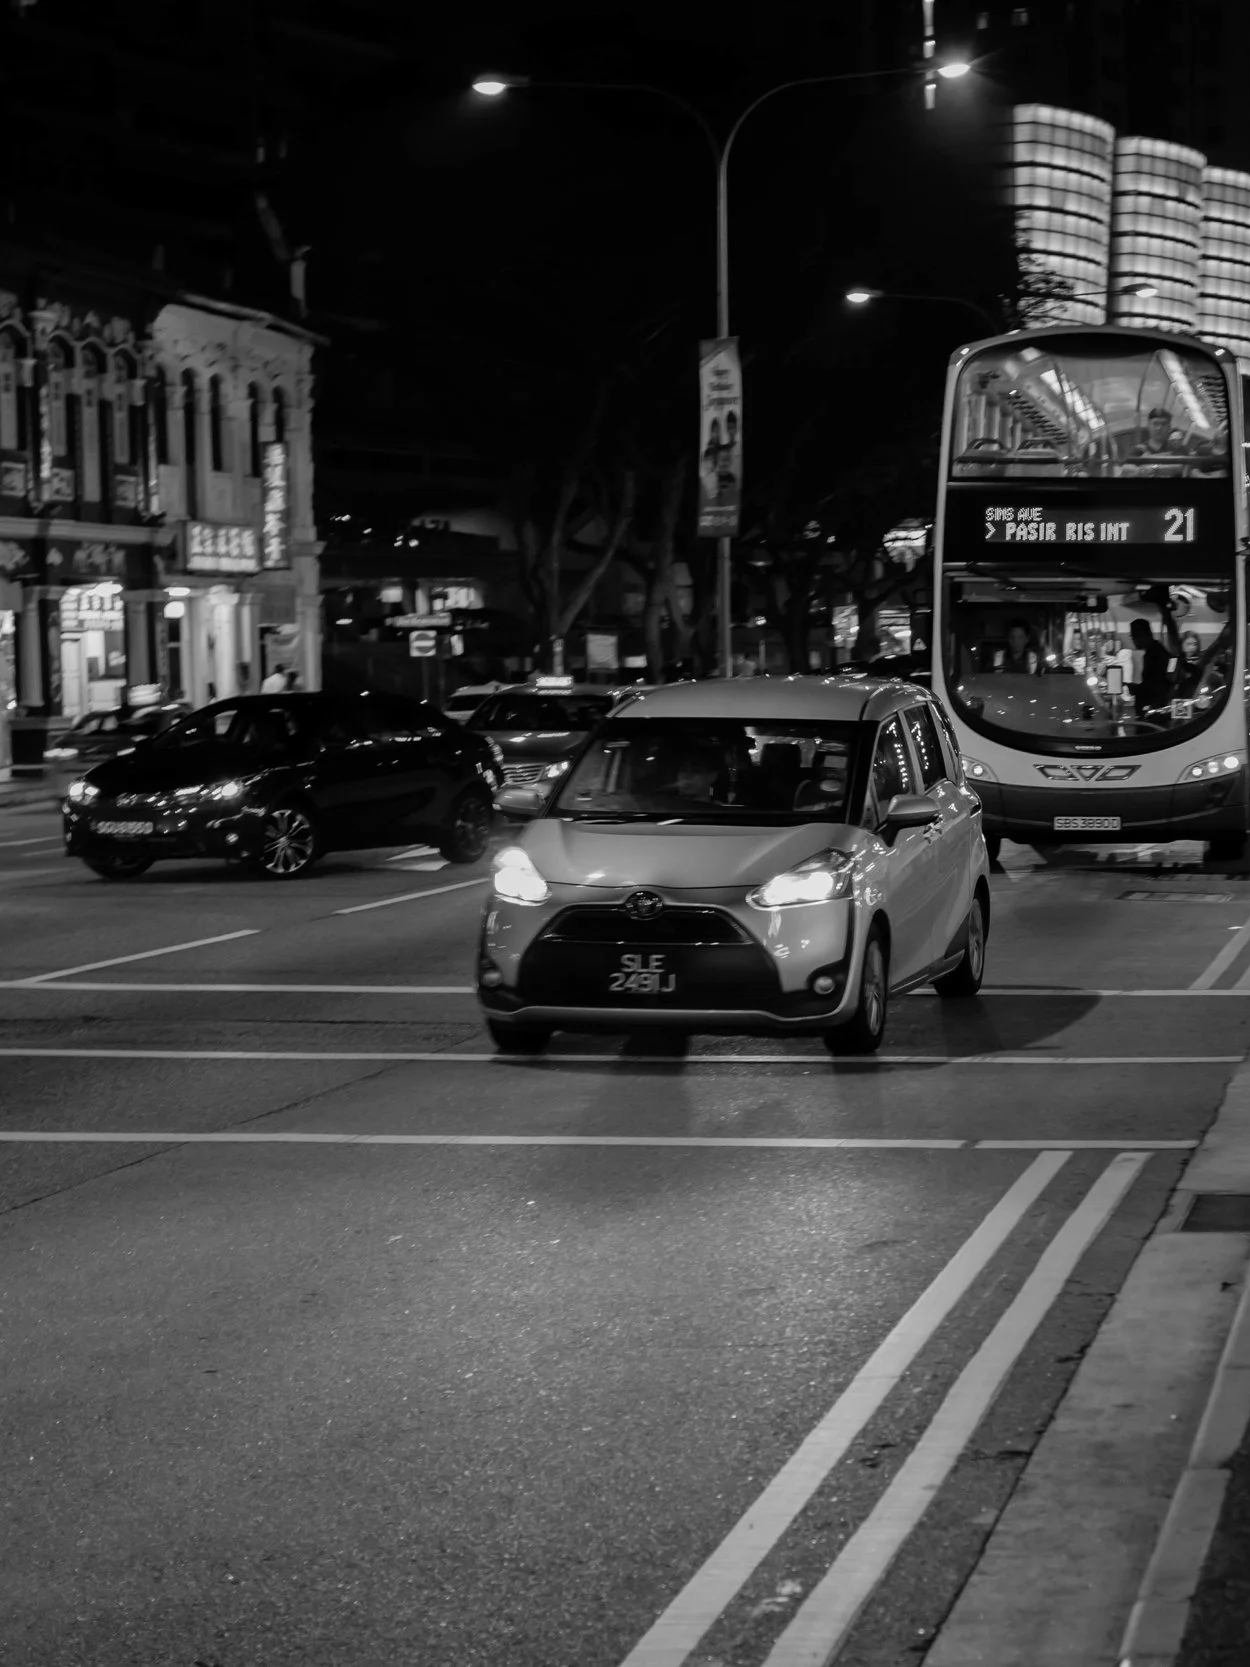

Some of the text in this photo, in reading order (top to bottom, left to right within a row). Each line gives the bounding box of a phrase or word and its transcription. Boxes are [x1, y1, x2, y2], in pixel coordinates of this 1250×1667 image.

[985, 507, 1043, 521] SIMS AVE
[1005, 522, 1130, 541] PASIR RIS INT
[1164, 508, 1194, 542] 21
[620, 953, 666, 973] SLE
